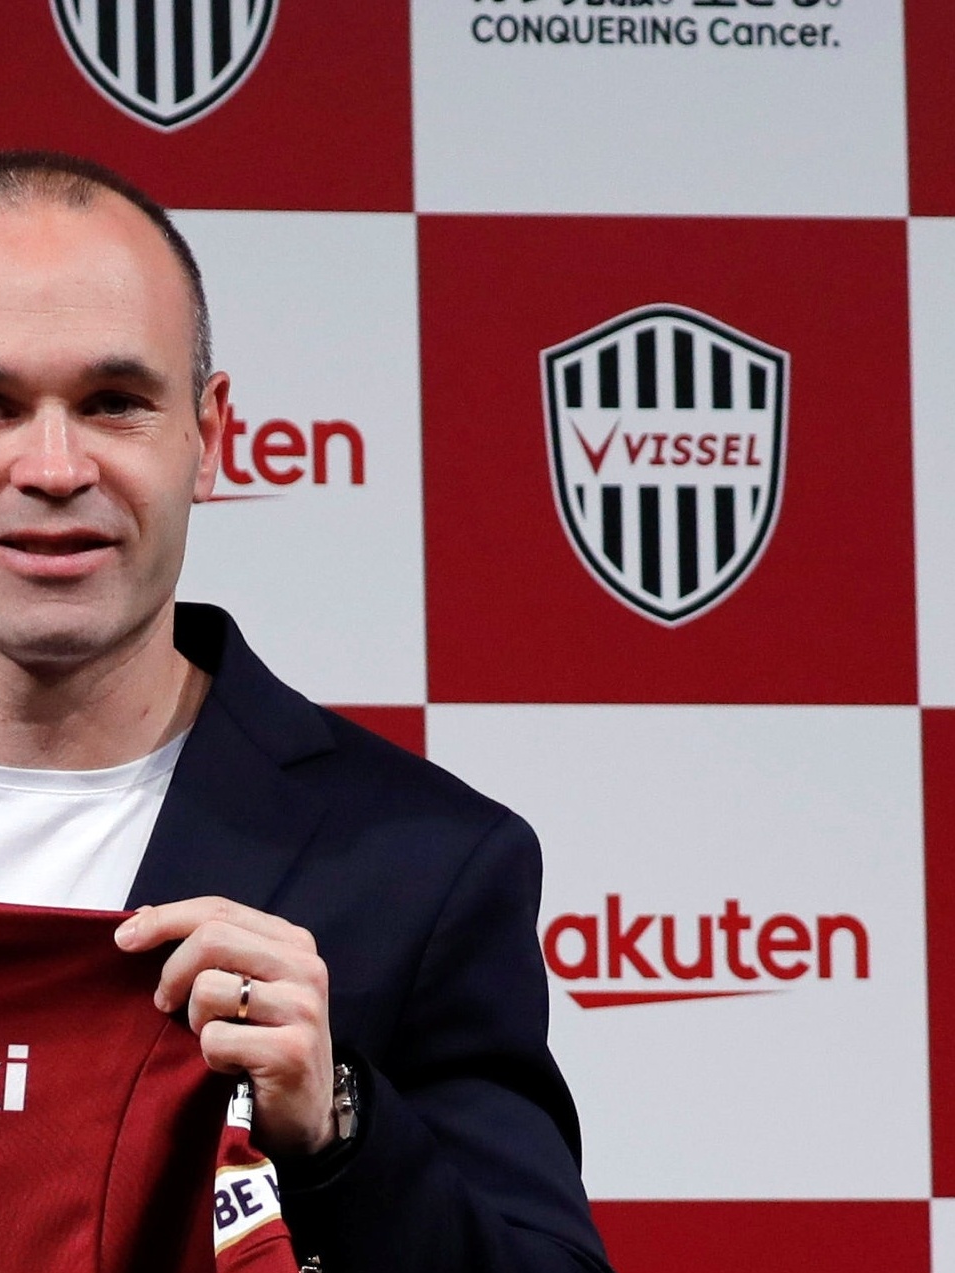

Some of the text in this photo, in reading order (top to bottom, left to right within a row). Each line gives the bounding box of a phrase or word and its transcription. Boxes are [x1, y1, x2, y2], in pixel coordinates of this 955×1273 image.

[471, 14, 841, 48] CONQUERING Cancer.
[623, 433, 762, 466] VISSEL
[542, 893, 871, 981] akuten
